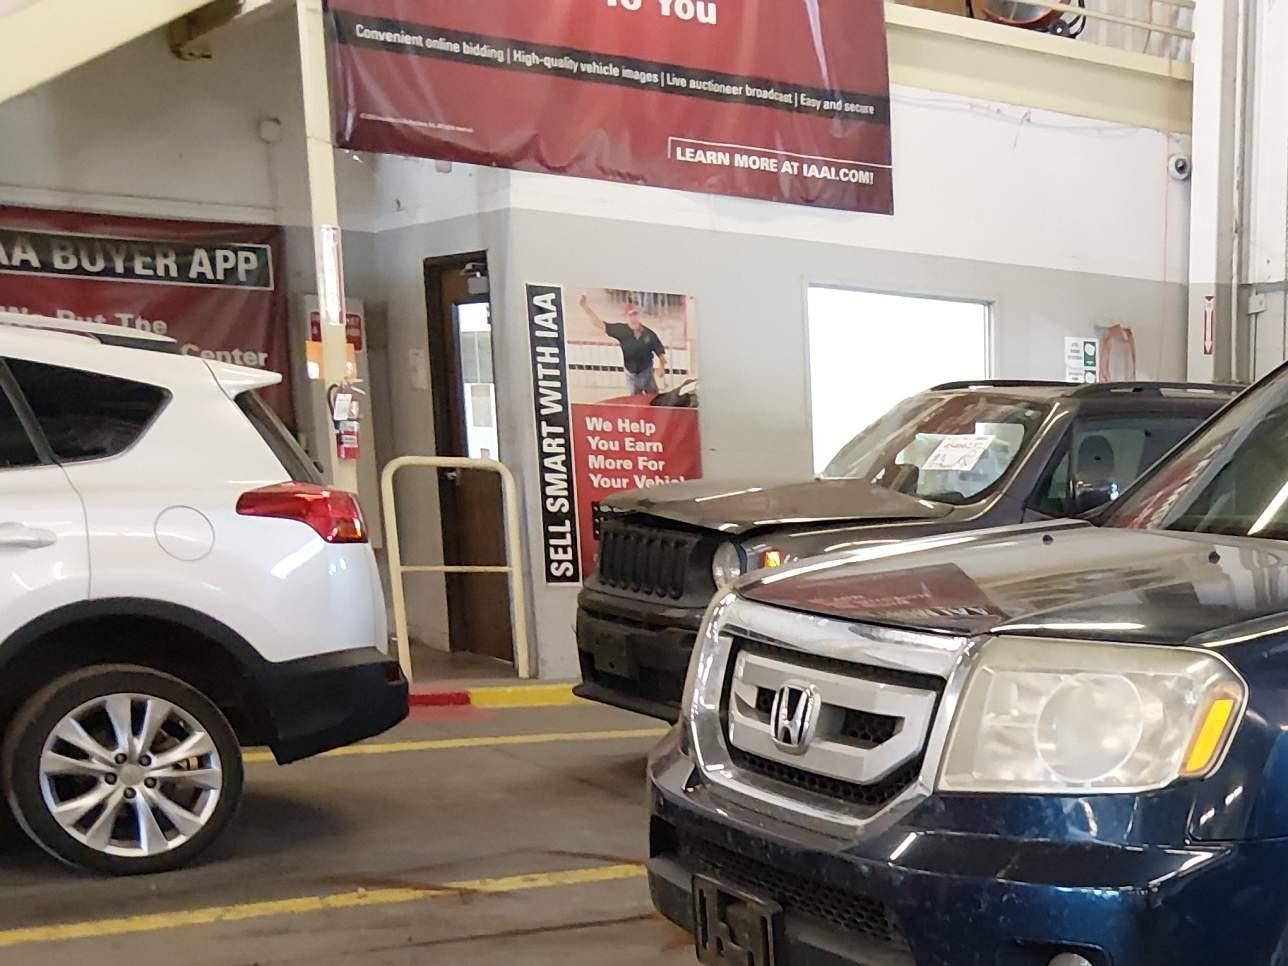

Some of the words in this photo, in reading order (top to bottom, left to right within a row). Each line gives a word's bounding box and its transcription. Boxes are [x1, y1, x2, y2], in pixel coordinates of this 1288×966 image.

[355, 24, 424, 48] Convenient
[425, 37, 460, 53] online
[462, 42, 505, 62] bidding
[513, 49, 578, 73] High-quality
[580, 60, 619, 77] vehicle
[622, 67, 659, 84] images
[667, 73, 687, 88] Live
[689, 78, 743, 96] auctioneer
[745, 84, 793, 104] broadcast
[800, 93, 822, 111] Easy
[823, 99, 843, 112] and
[844, 102, 875, 115] secure
[676, 147, 730, 166] LEARN
[734, 153, 778, 172] MORE
[781, 160, 800, 175] AT
[52, 239, 179, 278] BUYER
[188, 248, 259, 282] APP
[532, 292, 559, 338] IAA
[535, 346, 563, 415] WITH
[585, 416, 613, 432] We
[617, 418, 656, 436] Help
[586, 436, 619, 451] You
[624, 437, 663, 452] Earn
[541, 420, 570, 513] SMART
[588, 454, 633, 470] More
[637, 456, 665, 471] For
[589, 473, 629, 489] Your
[548, 519, 574, 577] SELL
